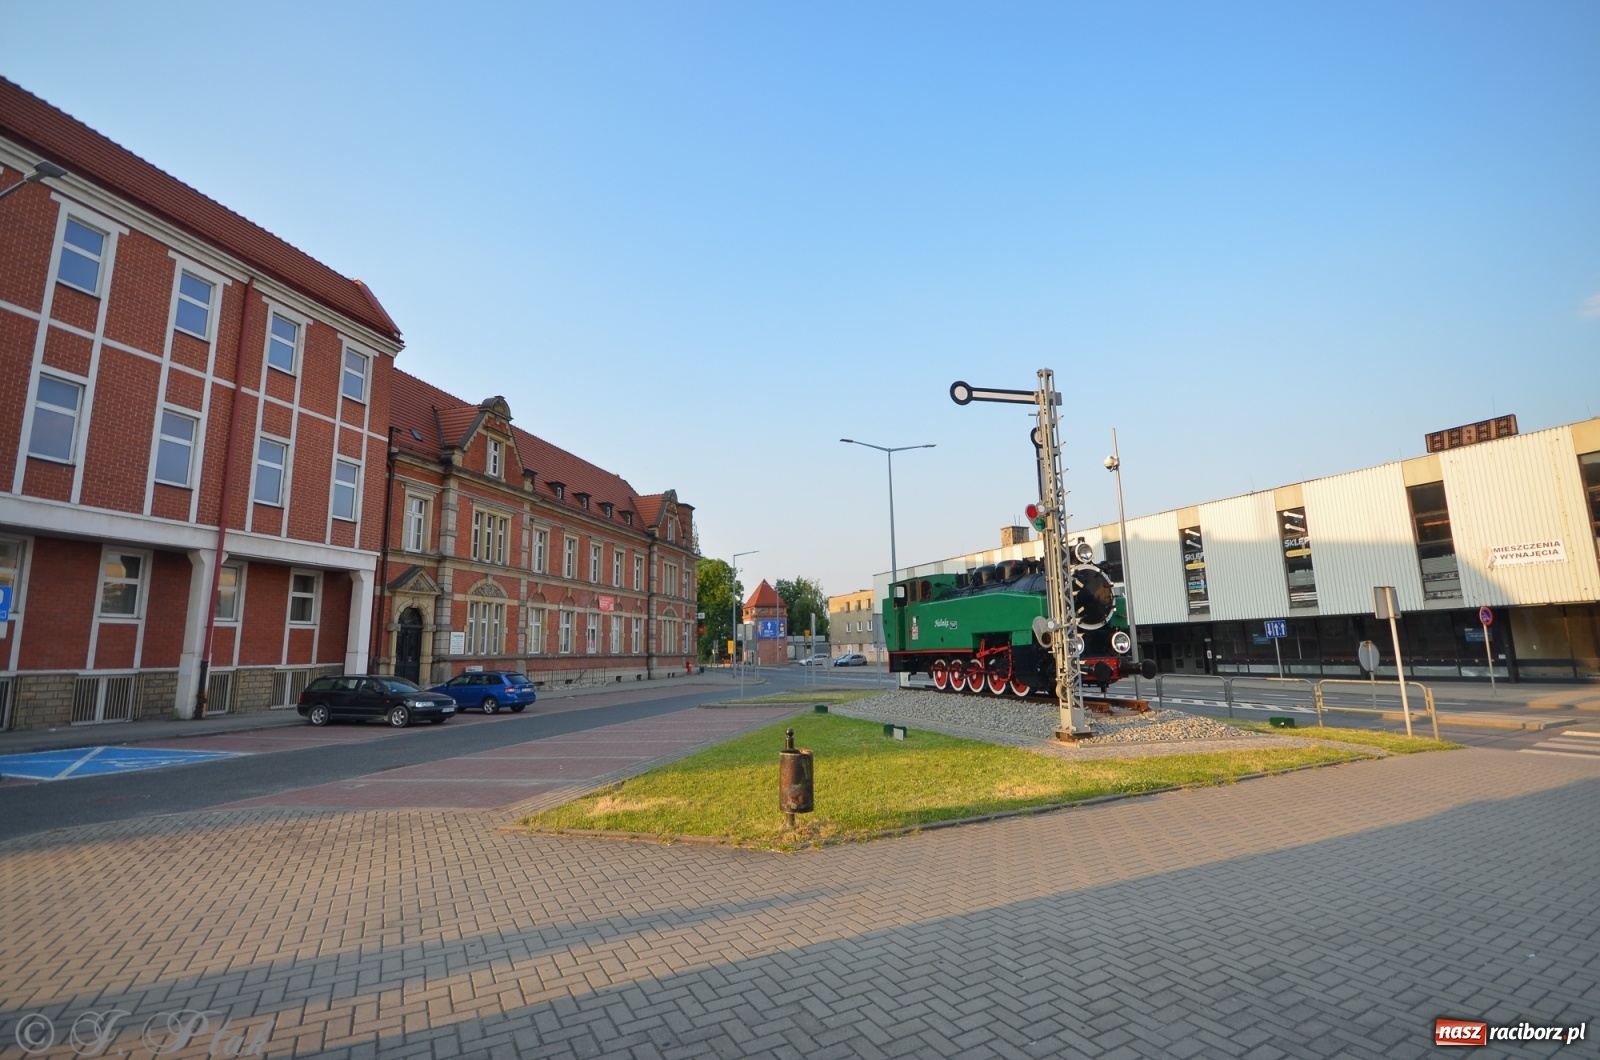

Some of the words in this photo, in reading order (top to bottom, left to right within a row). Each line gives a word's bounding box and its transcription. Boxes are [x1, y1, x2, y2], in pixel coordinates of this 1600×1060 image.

[1284, 536, 1310, 548] SKLEP
[1491, 541, 1561, 553] MIESZCZENIA
[1184, 551, 1205, 562] SKLEP
[1500, 549, 1560, 560] WYNAJĘCIA
